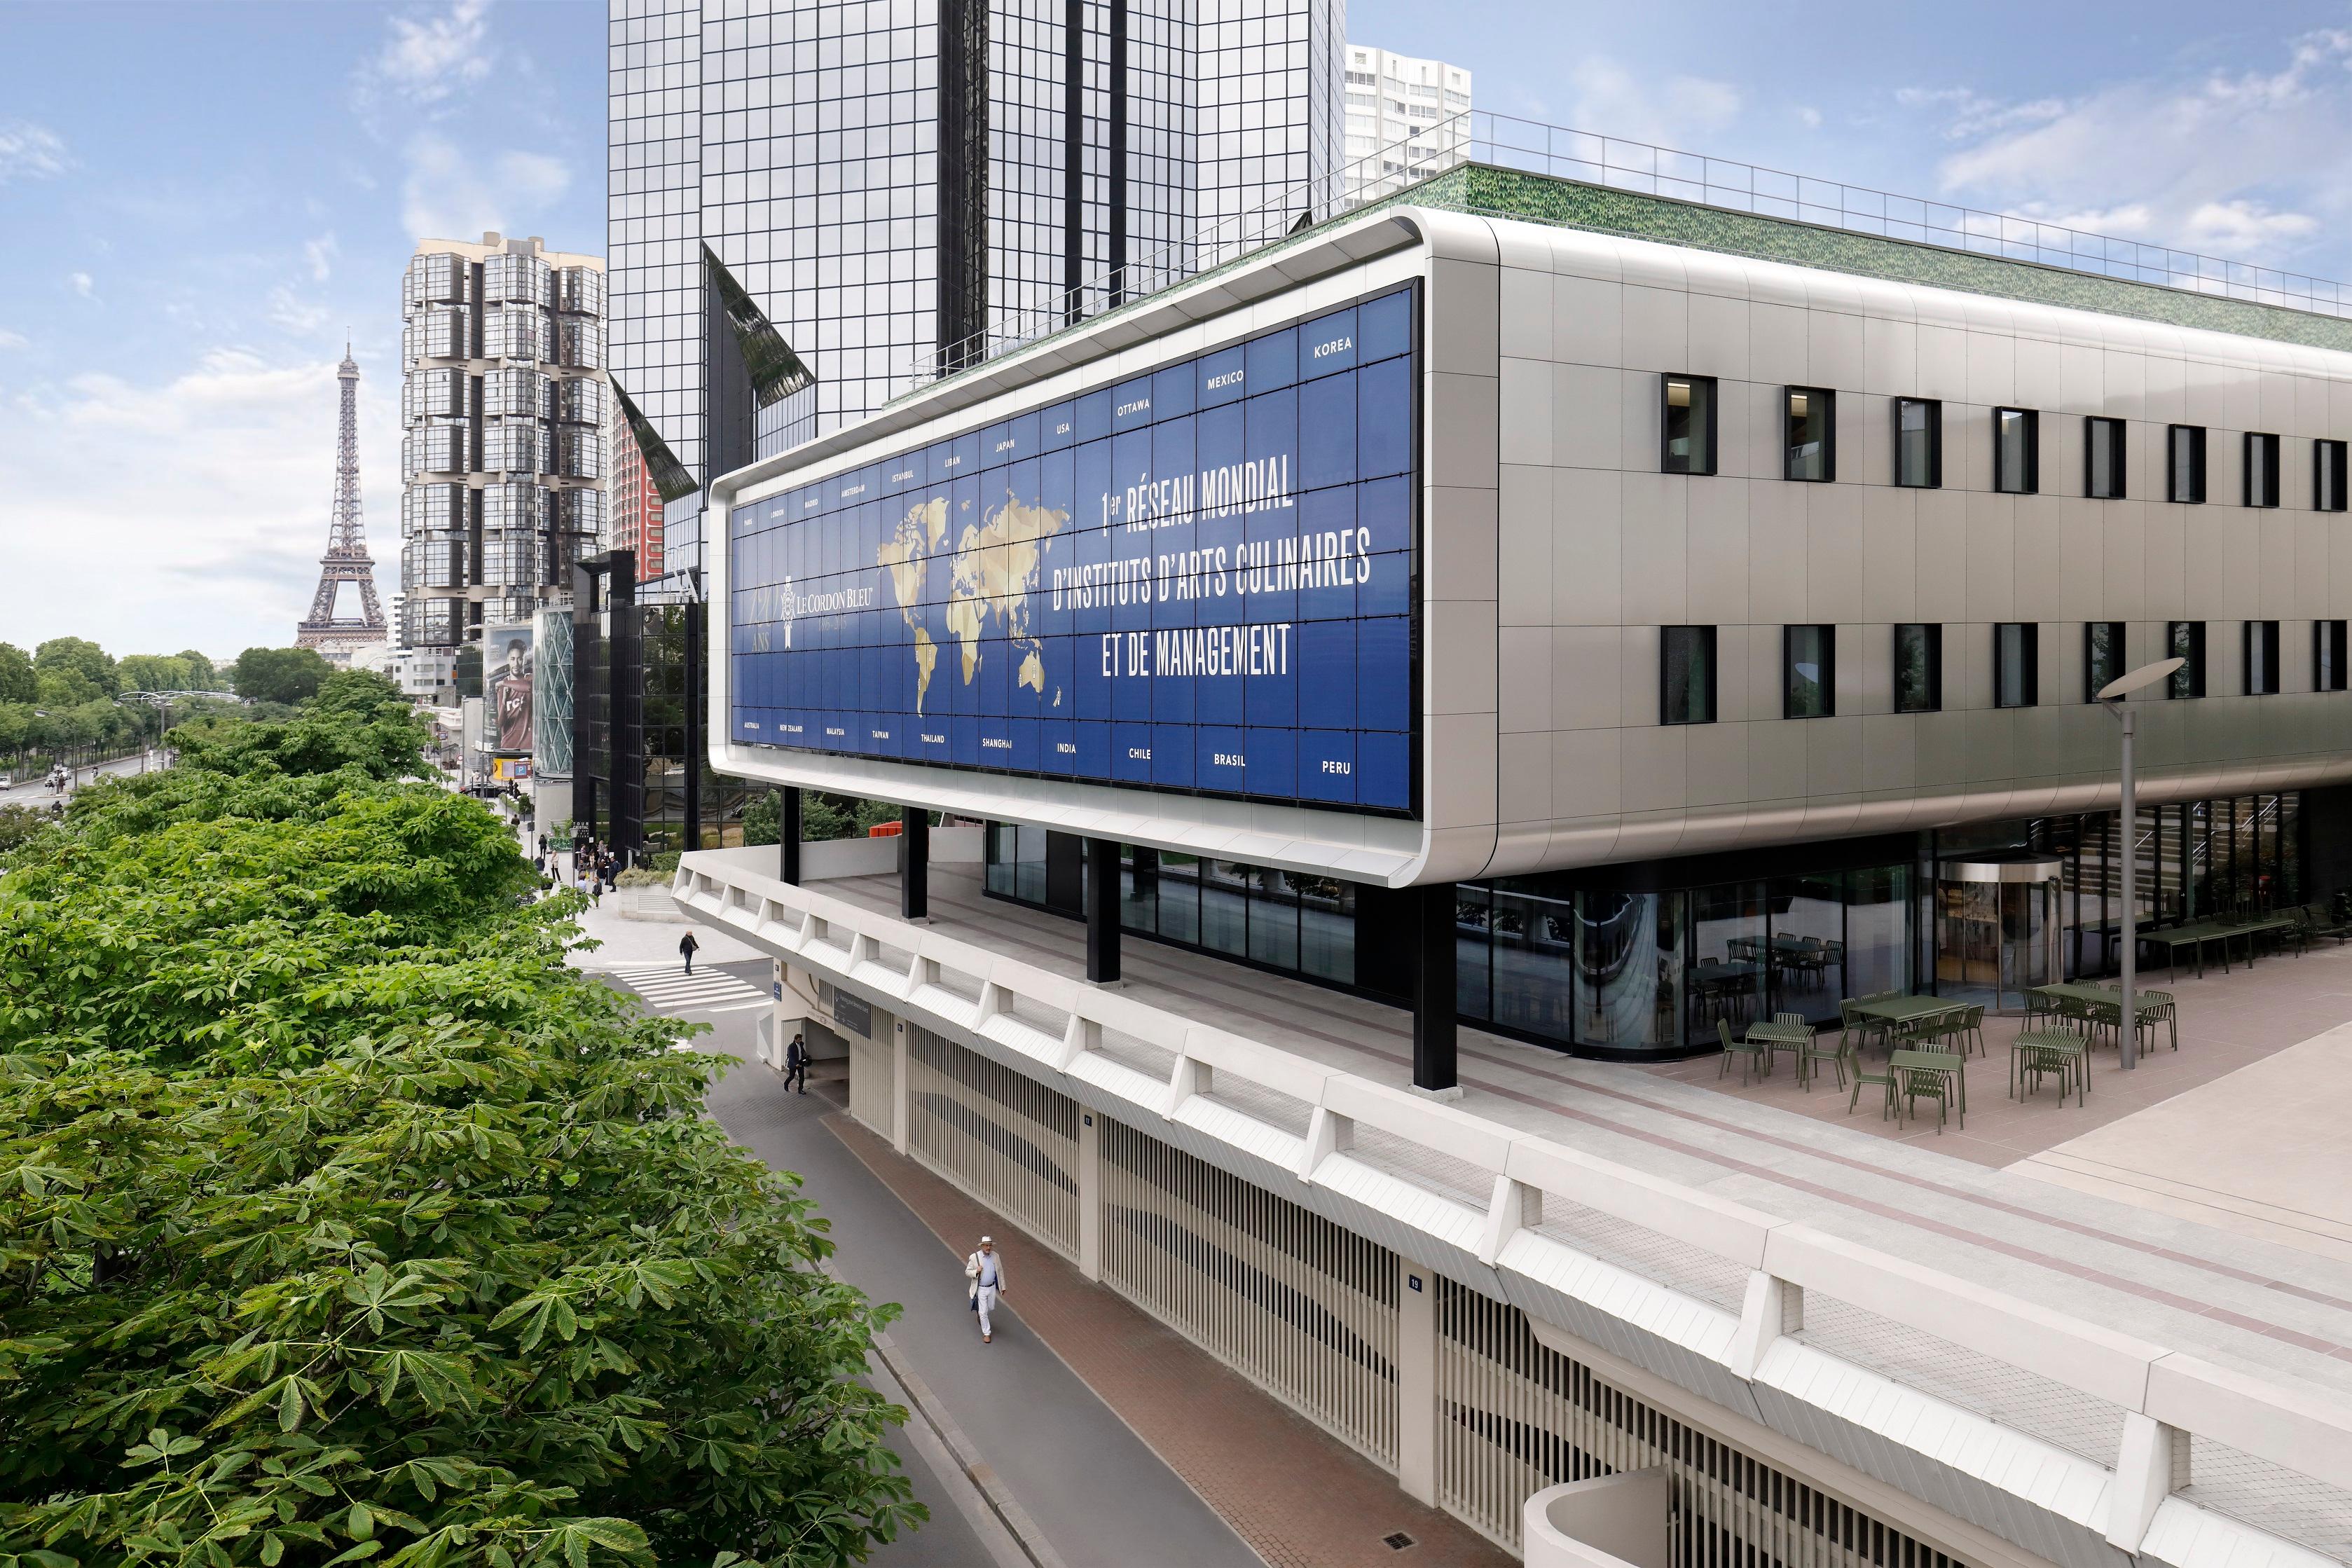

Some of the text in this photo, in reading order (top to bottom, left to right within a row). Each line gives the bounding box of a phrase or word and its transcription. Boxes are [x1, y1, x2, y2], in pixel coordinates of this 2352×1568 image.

[1314, 336, 1352, 358] KOREA
[1207, 369, 1244, 390] MEXICO
[1117, 398, 1150, 416] OTTAWA
[1057, 422, 1070, 434] USA
[996, 439, 1015, 453] JAPAN
[944, 455, 960, 467] LIBAN
[892, 469, 914, 482] ISTANBUL
[841, 484, 865, 497] AMSTERDAM
[1102, 454, 1293, 537] 1er RÉSEAU MONDIAL
[805, 499, 818, 509] MADRID
[771, 509, 784, 518] LONDON
[1053, 526, 1370, 611] D'INSTITUTS D'ARTS CULINAIRES
[797, 588, 872, 614] LE CORDON BLEU
[752, 632, 769, 652] ANS
[1102, 624, 1291, 677] ET DE MANAGEMENT
[826, 727, 845, 736] MALAYSIA
[872, 731, 889, 739] TAIWAN
[921, 734, 944, 743] THAILAND
[982, 738, 1012, 749] SHANGHAI
[1057, 743, 1076, 754] INDIA
[1129, 748, 1151, 759] CHILE
[1214, 754, 1246, 766] BRASIL
[1323, 761, 1350, 775] PERU
[1411, 1279, 1418, 1288] 19
